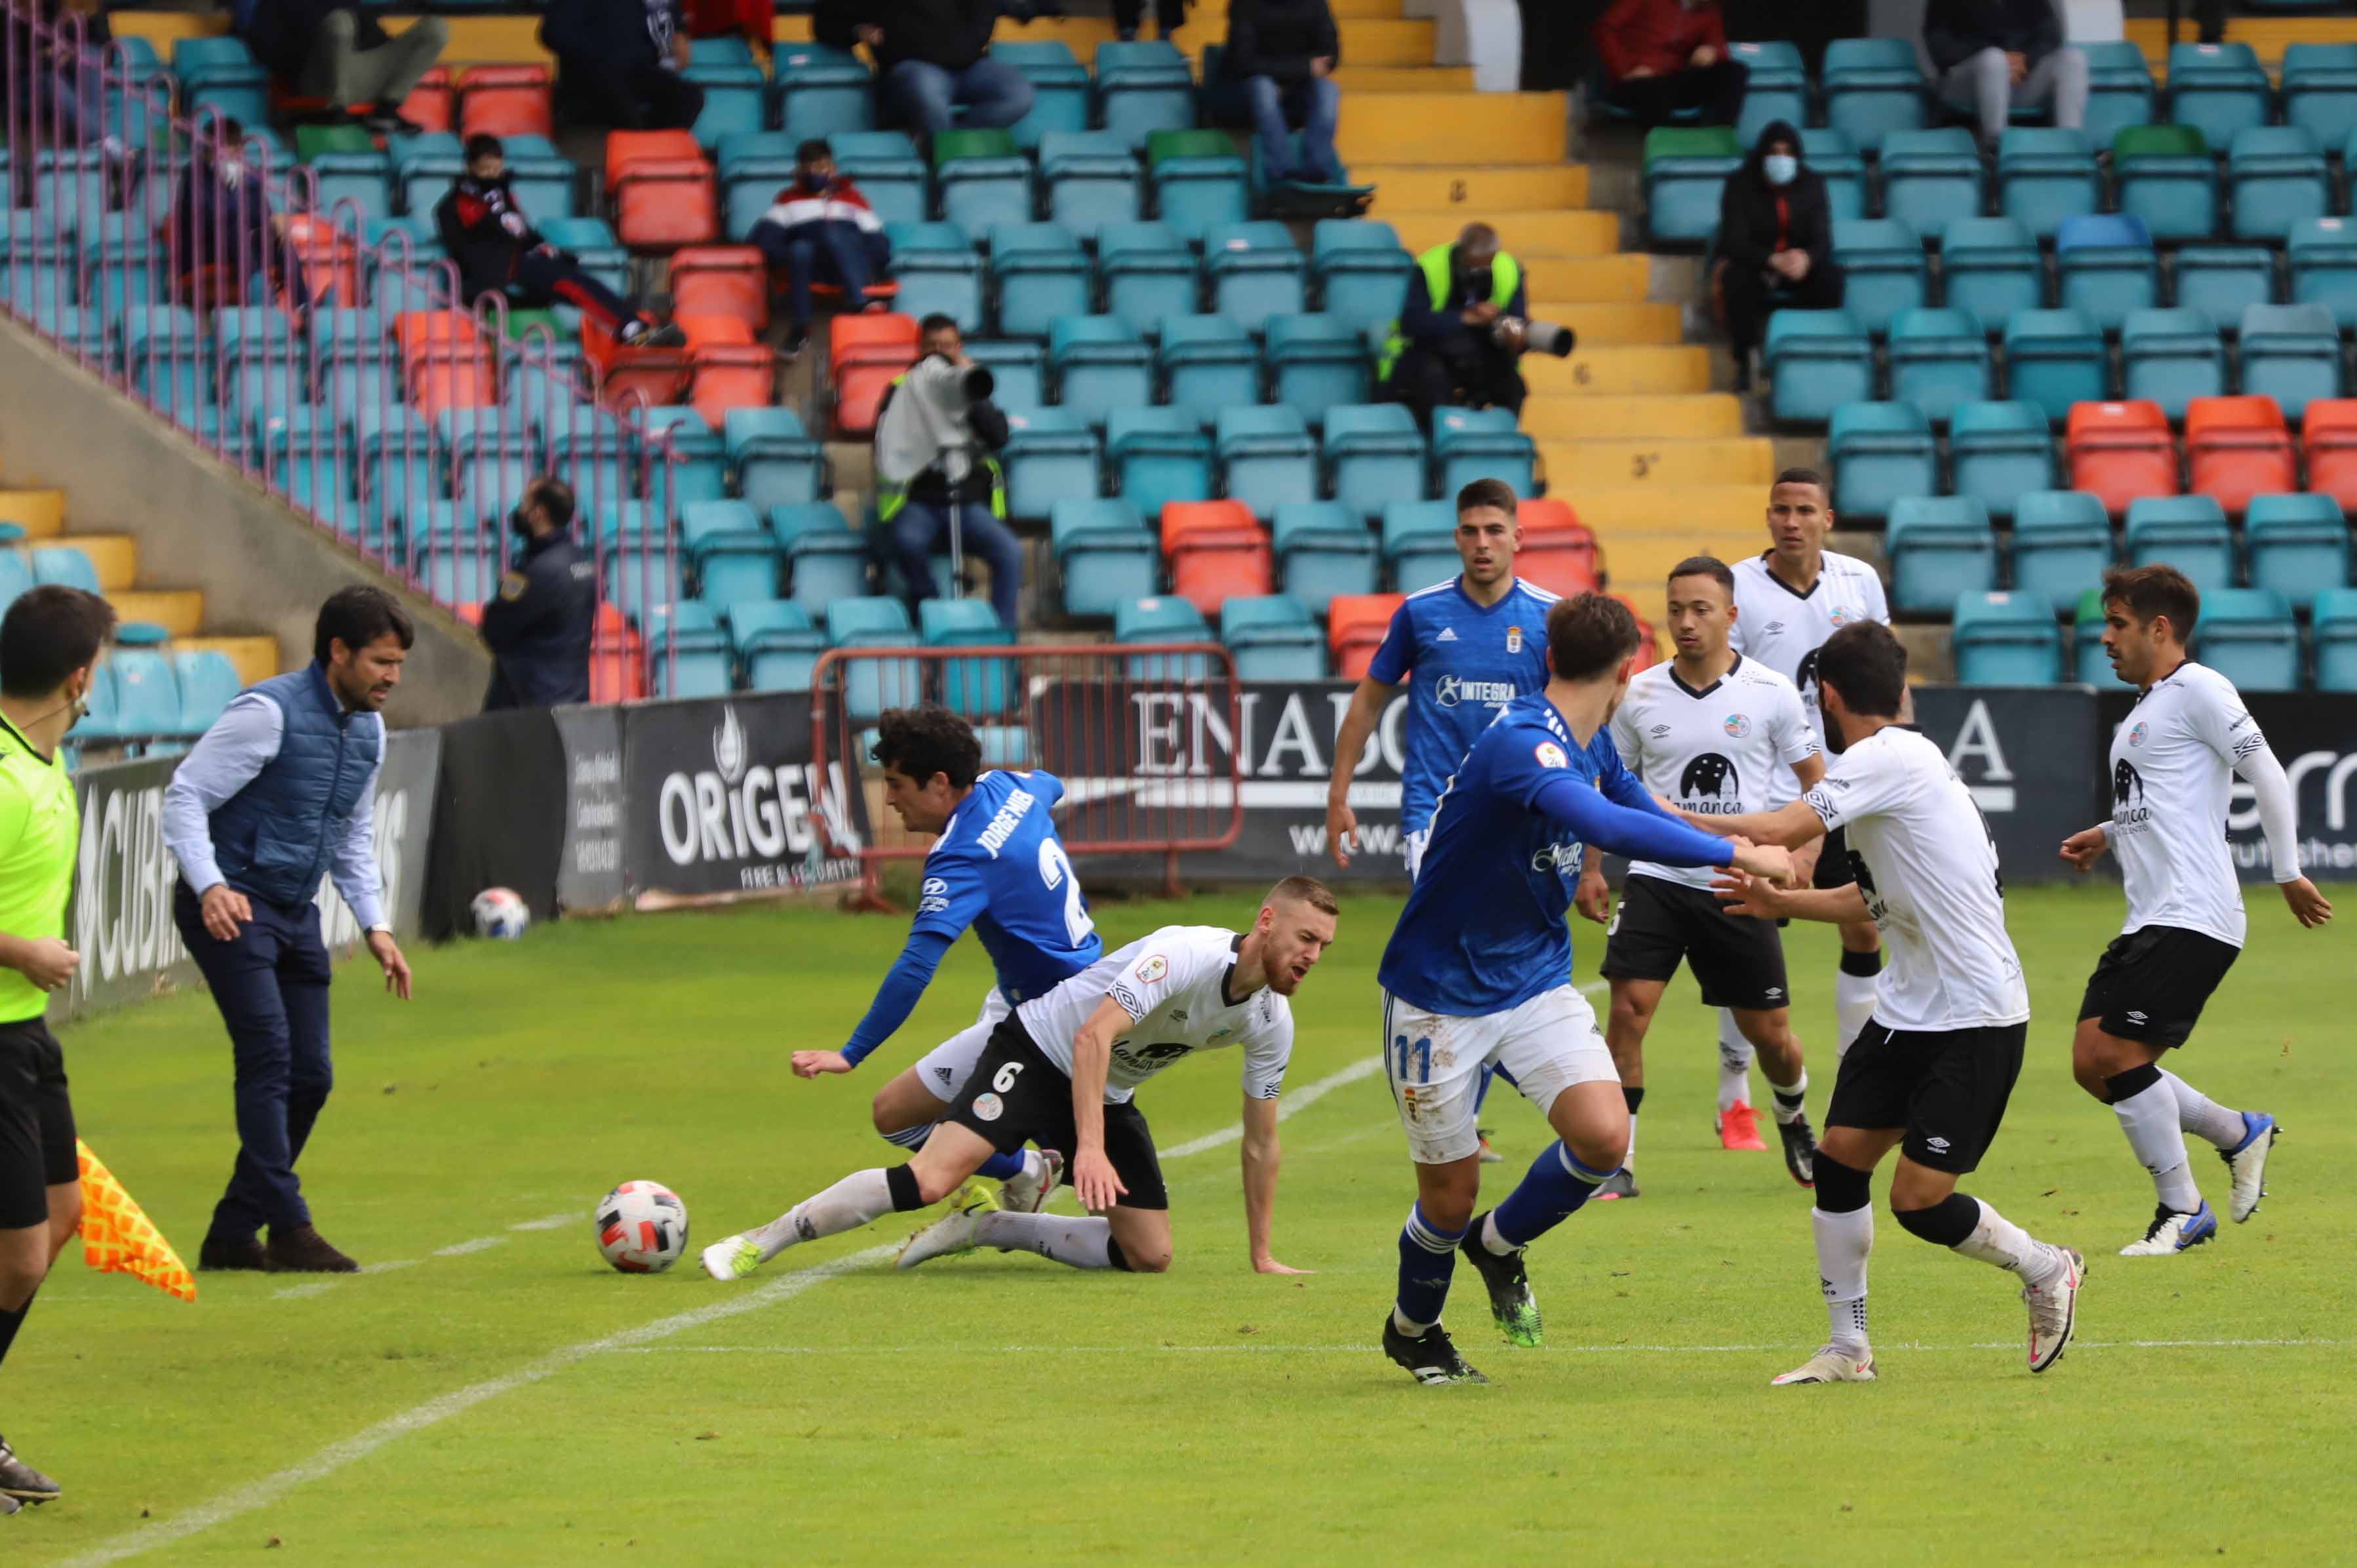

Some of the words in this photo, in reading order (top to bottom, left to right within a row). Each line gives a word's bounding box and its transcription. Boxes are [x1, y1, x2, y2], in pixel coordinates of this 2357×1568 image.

[1461, 681, 1515, 701] INTEGRA
[976, 808, 1020, 859] JORGE
[1039, 837, 1094, 949] 2
[993, 1061, 1024, 1093] 6
[1395, 1034, 1431, 1084] 11
